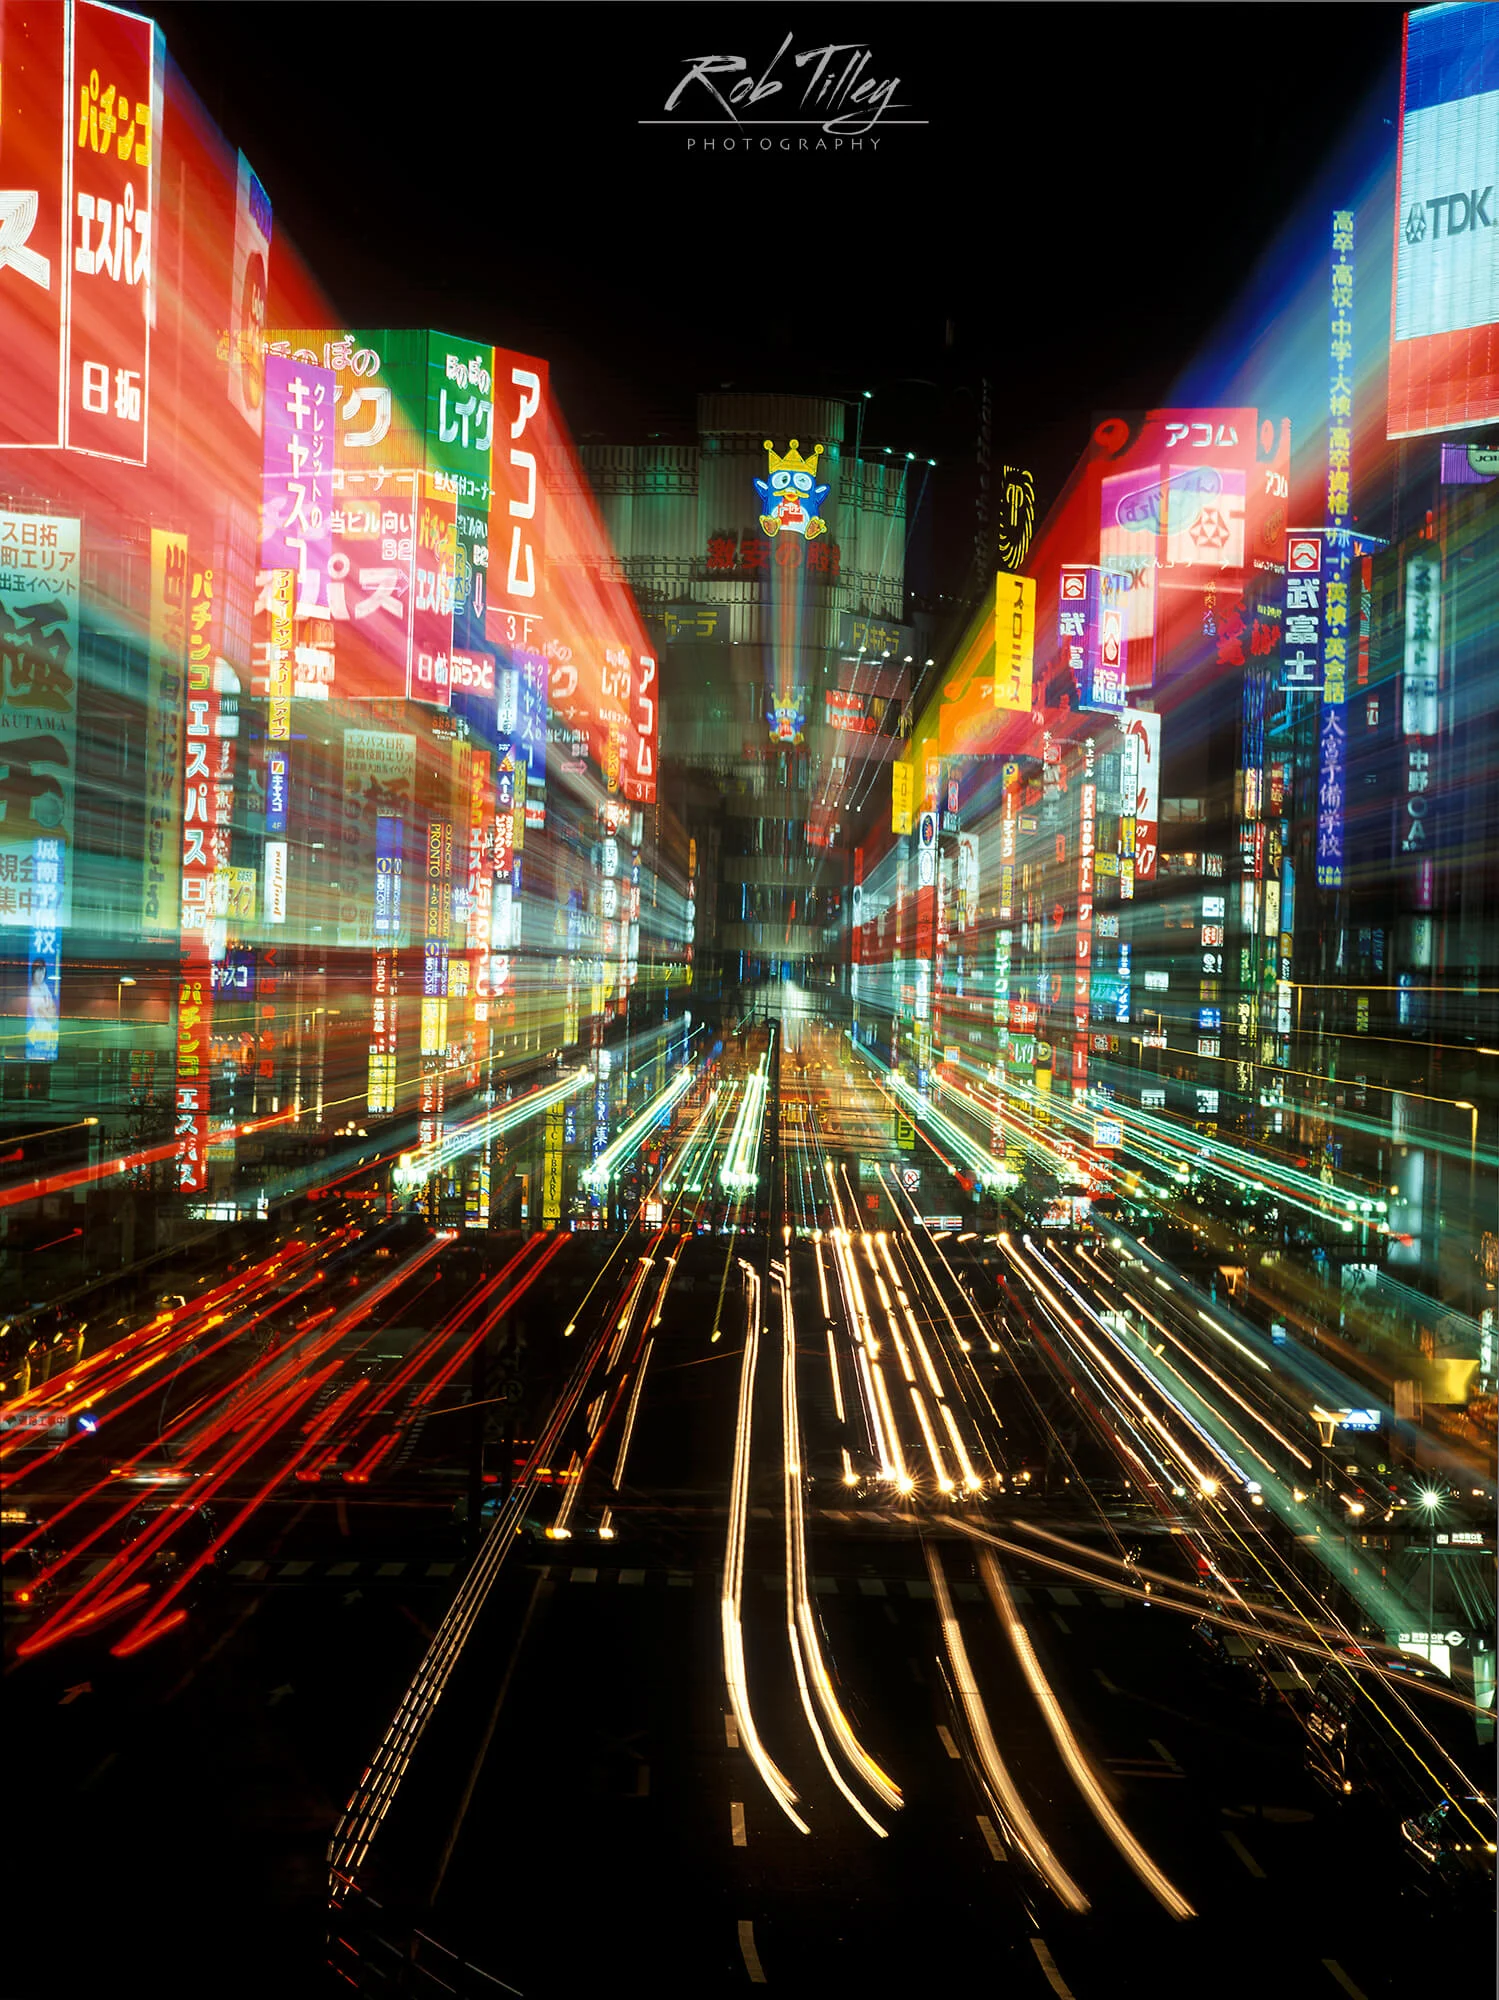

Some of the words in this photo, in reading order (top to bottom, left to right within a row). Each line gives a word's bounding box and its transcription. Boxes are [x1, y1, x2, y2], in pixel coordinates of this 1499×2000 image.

[79, 69, 151, 166] パチンコ
[76, 182, 151, 286] エスパス
[1426, 186, 1495, 240] TDK
[82, 360, 141, 421] 日拓
[439, 388, 492, 452] レイク
[1165, 423, 1239, 448] アコム
[507, 367, 541, 600] アコム
[189, 570, 213, 689] パチンコ
[507, 616, 534, 643] 3F
[1285, 578, 1320, 682] 武富士
[637, 655, 655, 776] アコム
[185, 700, 211, 867] エスパス
[429, 823, 442, 878] PRONTO
[178, 983, 201, 1077] パチンコ
